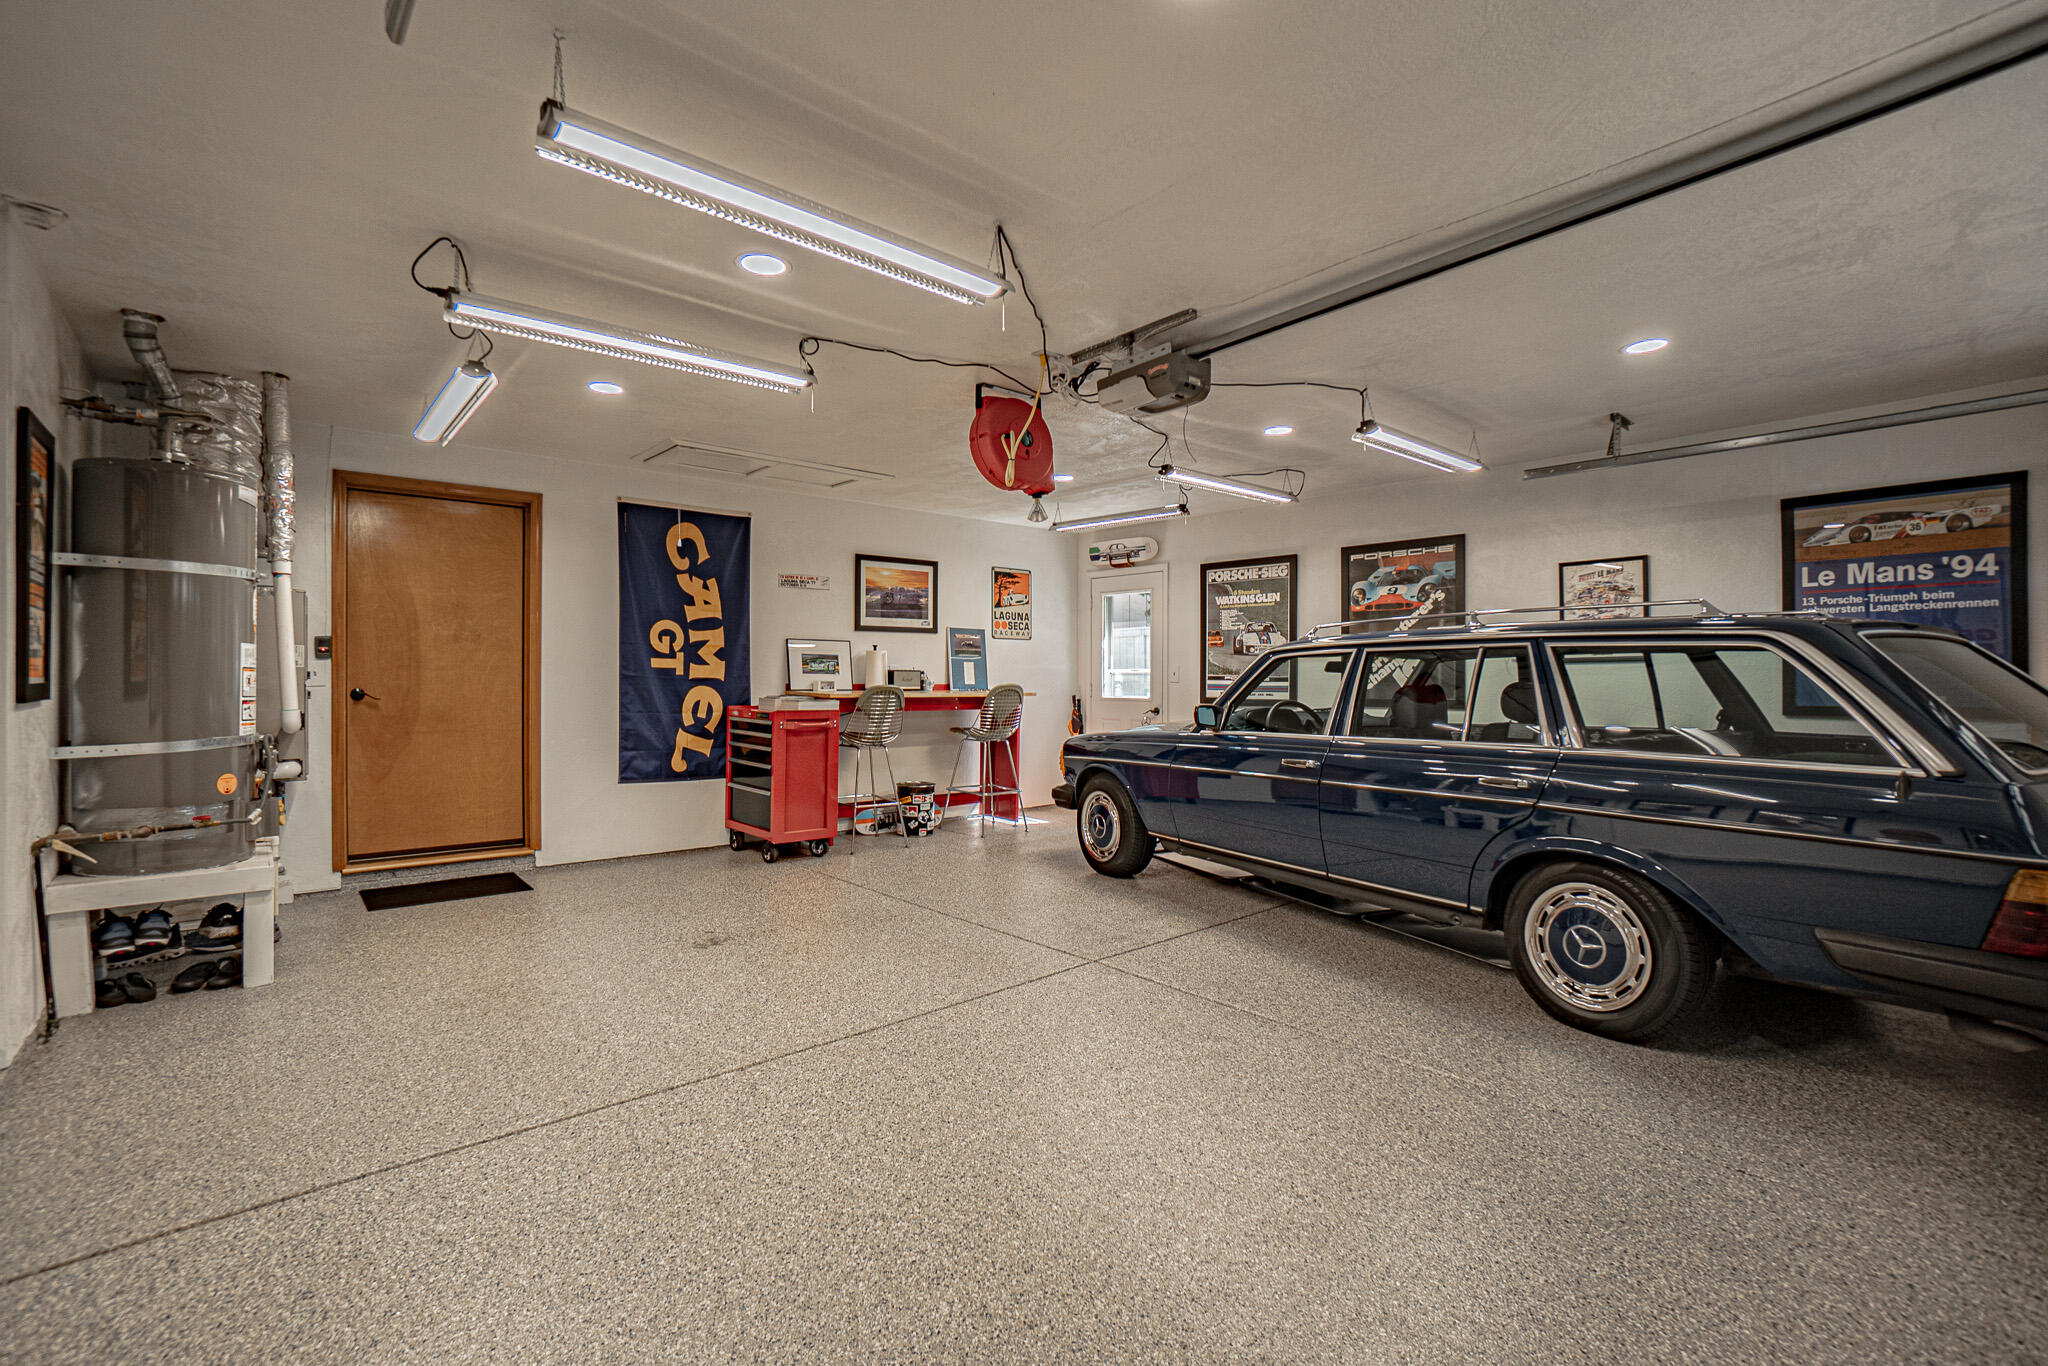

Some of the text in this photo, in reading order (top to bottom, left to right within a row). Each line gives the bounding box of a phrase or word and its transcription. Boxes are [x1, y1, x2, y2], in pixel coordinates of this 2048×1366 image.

[1350, 544, 1456, 562] PORSCHE
[1801, 552, 2000, 588] Le Mans '94
[1214, 594, 1255, 606] WATKINS
[1255, 592, 1281, 603] GLEN
[1802, 590, 1955, 607] 13. Porsche-Triumph beim
[1869, 598, 1999, 613] Langstreckenrennen
[994, 610, 1030, 622] LAGUNA
[1007, 621, 1030, 632] SECA
[649, 619, 685, 676] GT
